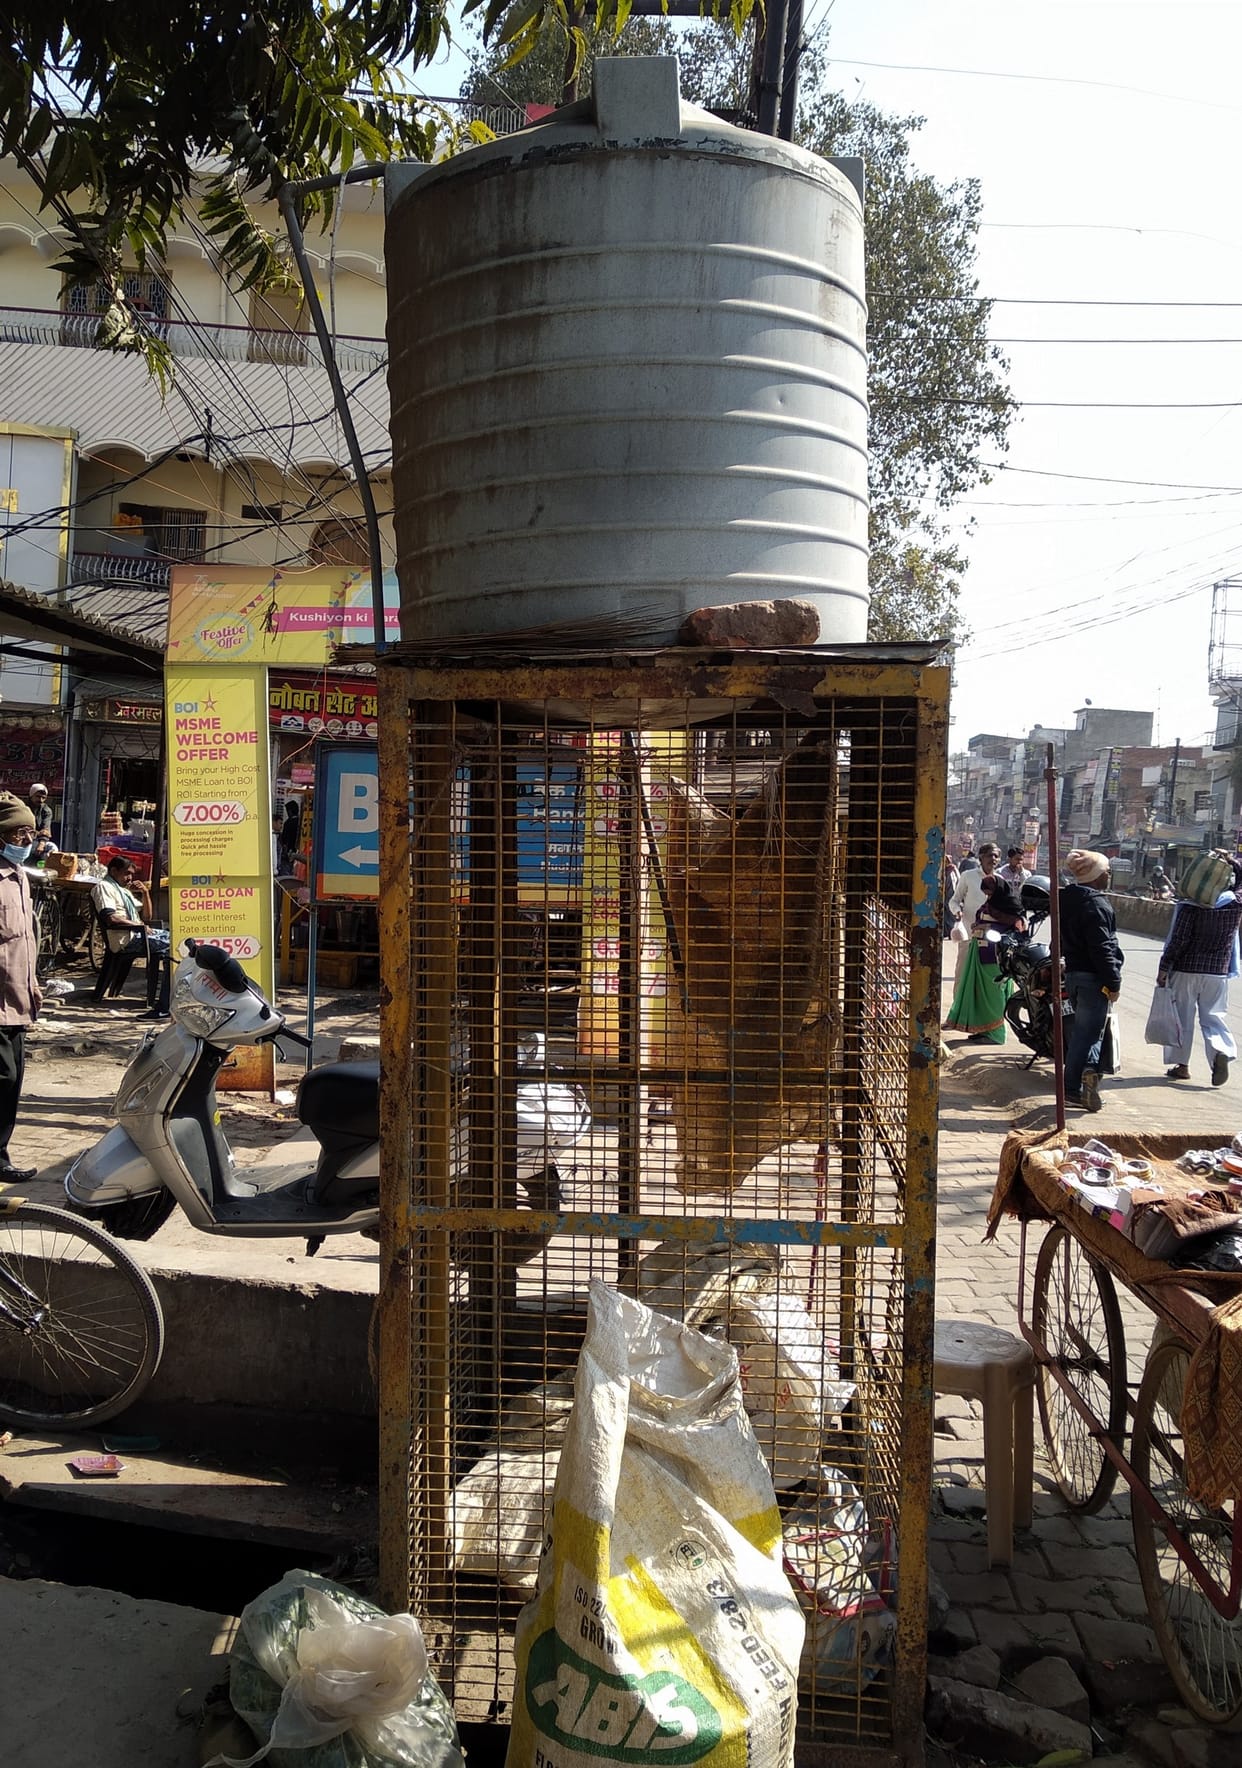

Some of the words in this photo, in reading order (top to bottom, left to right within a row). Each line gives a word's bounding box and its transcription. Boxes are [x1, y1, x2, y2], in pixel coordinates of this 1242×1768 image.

[289, 612, 352, 623] Kushiyon
[356, 613, 368, 622] ki
[200, 625, 246, 640] Festive
[217, 637, 244, 649] Offer
[174, 702, 199, 714] BOI
[175, 717, 221, 731] MSME
[175, 731, 259, 746] WELCOME
[176, 748, 229, 762] OFFER
[176, 766, 198, 776] Bring
[200, 767, 218, 776] your
[221, 765, 240, 774] High
[242, 764, 260, 773] Cost
[176, 778, 202, 787] MSME
[204, 778, 225, 786] Loan
[238, 777, 253, 785] BOI
[176, 790, 192, 799] ROI
[194, 790, 227, 799] Starting
[228, 789, 248, 797] from
[182, 804, 240, 822] 7.00%
[191, 875, 211, 885] BOI
[180, 888, 215, 899] GOLD
[218, 887, 254, 898] LOAN
[180, 900, 231, 911] SCHEME
[179, 914, 211, 923] Lowest
[213, 913, 246, 922] Interest
[179, 925, 200, 934] Rate
[202, 924, 236, 934] starting
[574, 1585, 589, 1608] ISO
[741, 1635, 788, 1692] FEED
[531, 1662, 700, 1750] ABIS
